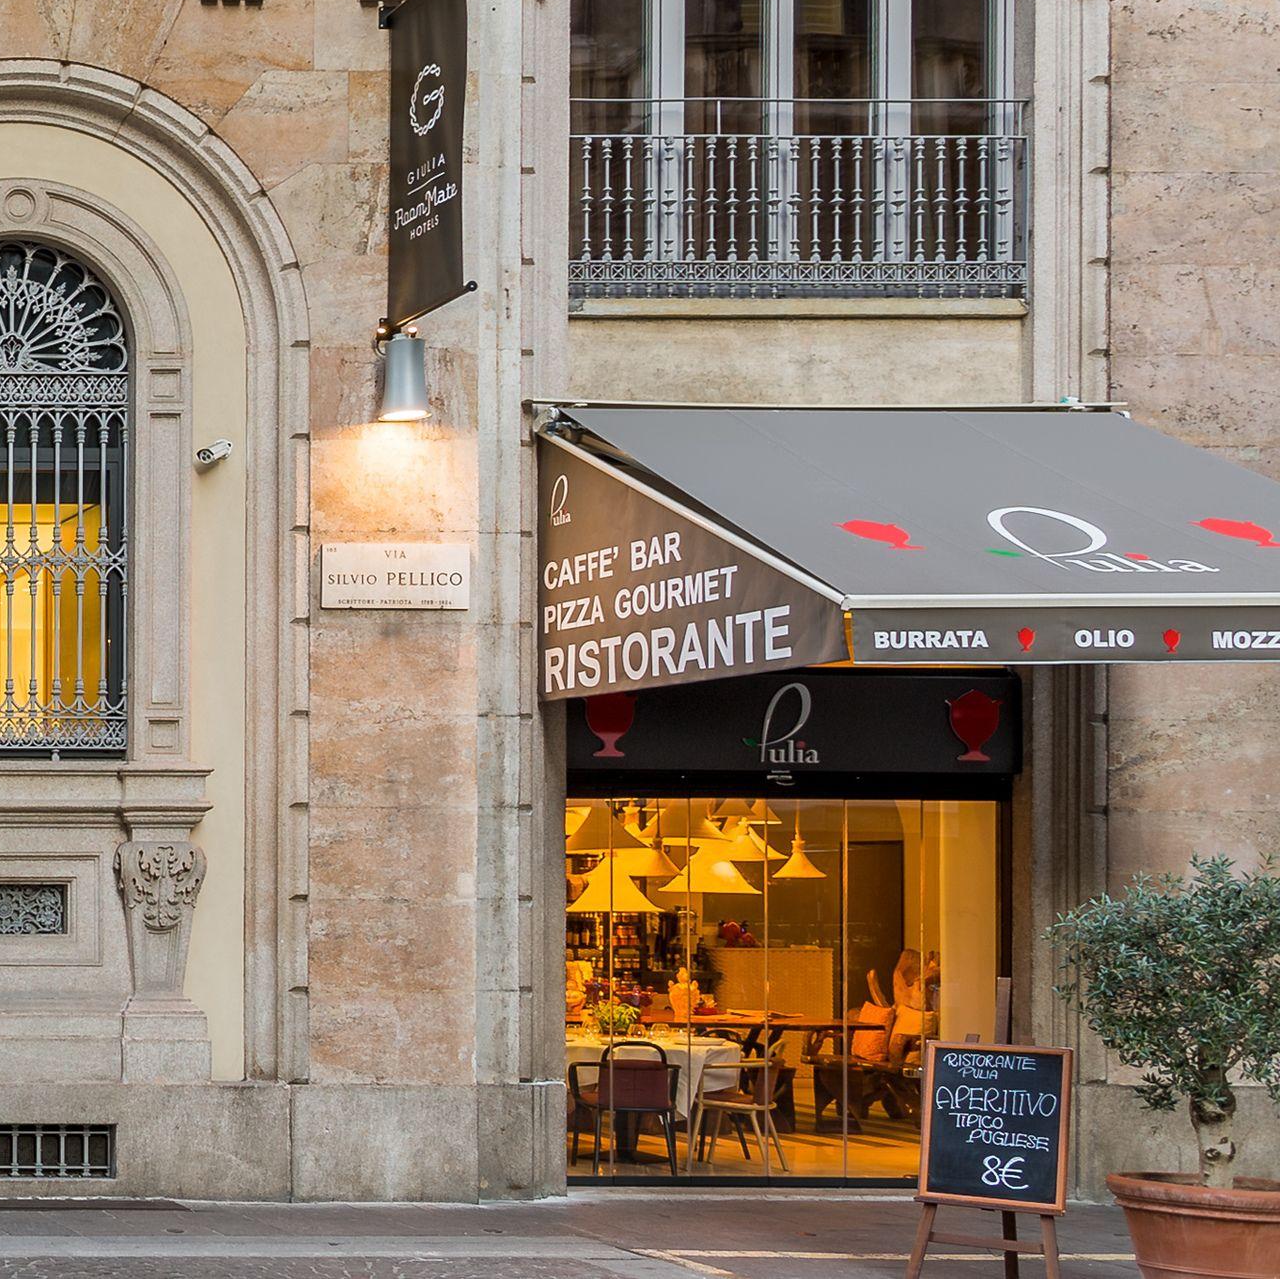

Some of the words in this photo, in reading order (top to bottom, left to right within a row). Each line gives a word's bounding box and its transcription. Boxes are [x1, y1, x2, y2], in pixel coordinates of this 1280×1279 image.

[407, 153, 446, 185] GIULIA
[410, 214, 439, 240] HOTELS
[385, 550, 407, 559] VIA
[630, 532, 682, 572] BAR
[328, 574, 377, 585] SILVIO
[387, 572, 463, 586] PELLICO
[544, 595, 605, 634] PIZZA
[614, 565, 738, 619] GOURMET
[545, 605, 792, 693] RISTORANTE
[873, 630, 989, 649] BURRATA
[1074, 629, 1135, 649] OLIO
[760, 682, 820, 763] Pulia
[943, 1053, 1037, 1071] RISTORANTE
[958, 1067, 999, 1080] PULIA
[936, 1085, 1057, 1117] APERITIVO
[966, 1128, 1050, 1152] PUGLIESE
[981, 1155, 1029, 1190] 8€
